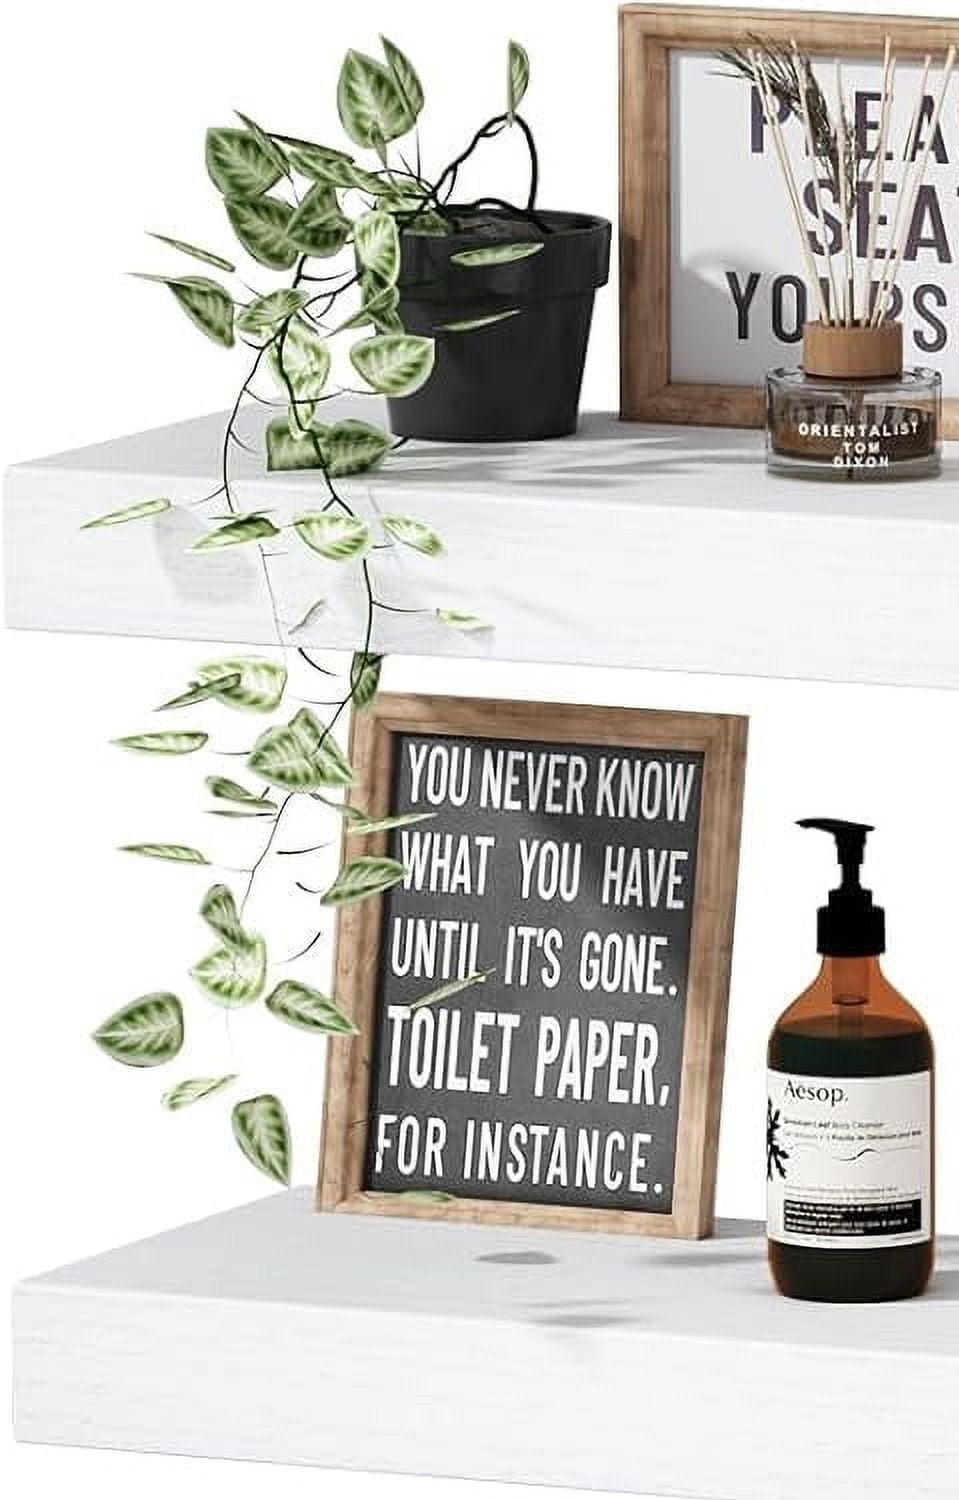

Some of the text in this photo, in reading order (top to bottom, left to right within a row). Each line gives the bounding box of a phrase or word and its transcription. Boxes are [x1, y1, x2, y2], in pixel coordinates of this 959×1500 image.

[799, 422, 918, 437] ORIENTALIST
[843, 442, 880, 454] TOM
[408, 744, 696, 822] YOU NEVER KNOW
[400, 831, 688, 909] WHAT YOU HAVE
[391, 918, 678, 996] UNTIL IT'S GONE.
[388, 1005, 670, 1107] TOILET PAPER,
[784, 1079, 848, 1107] Aesop.
[374, 1113, 663, 1194] FOR INSTANCE.
